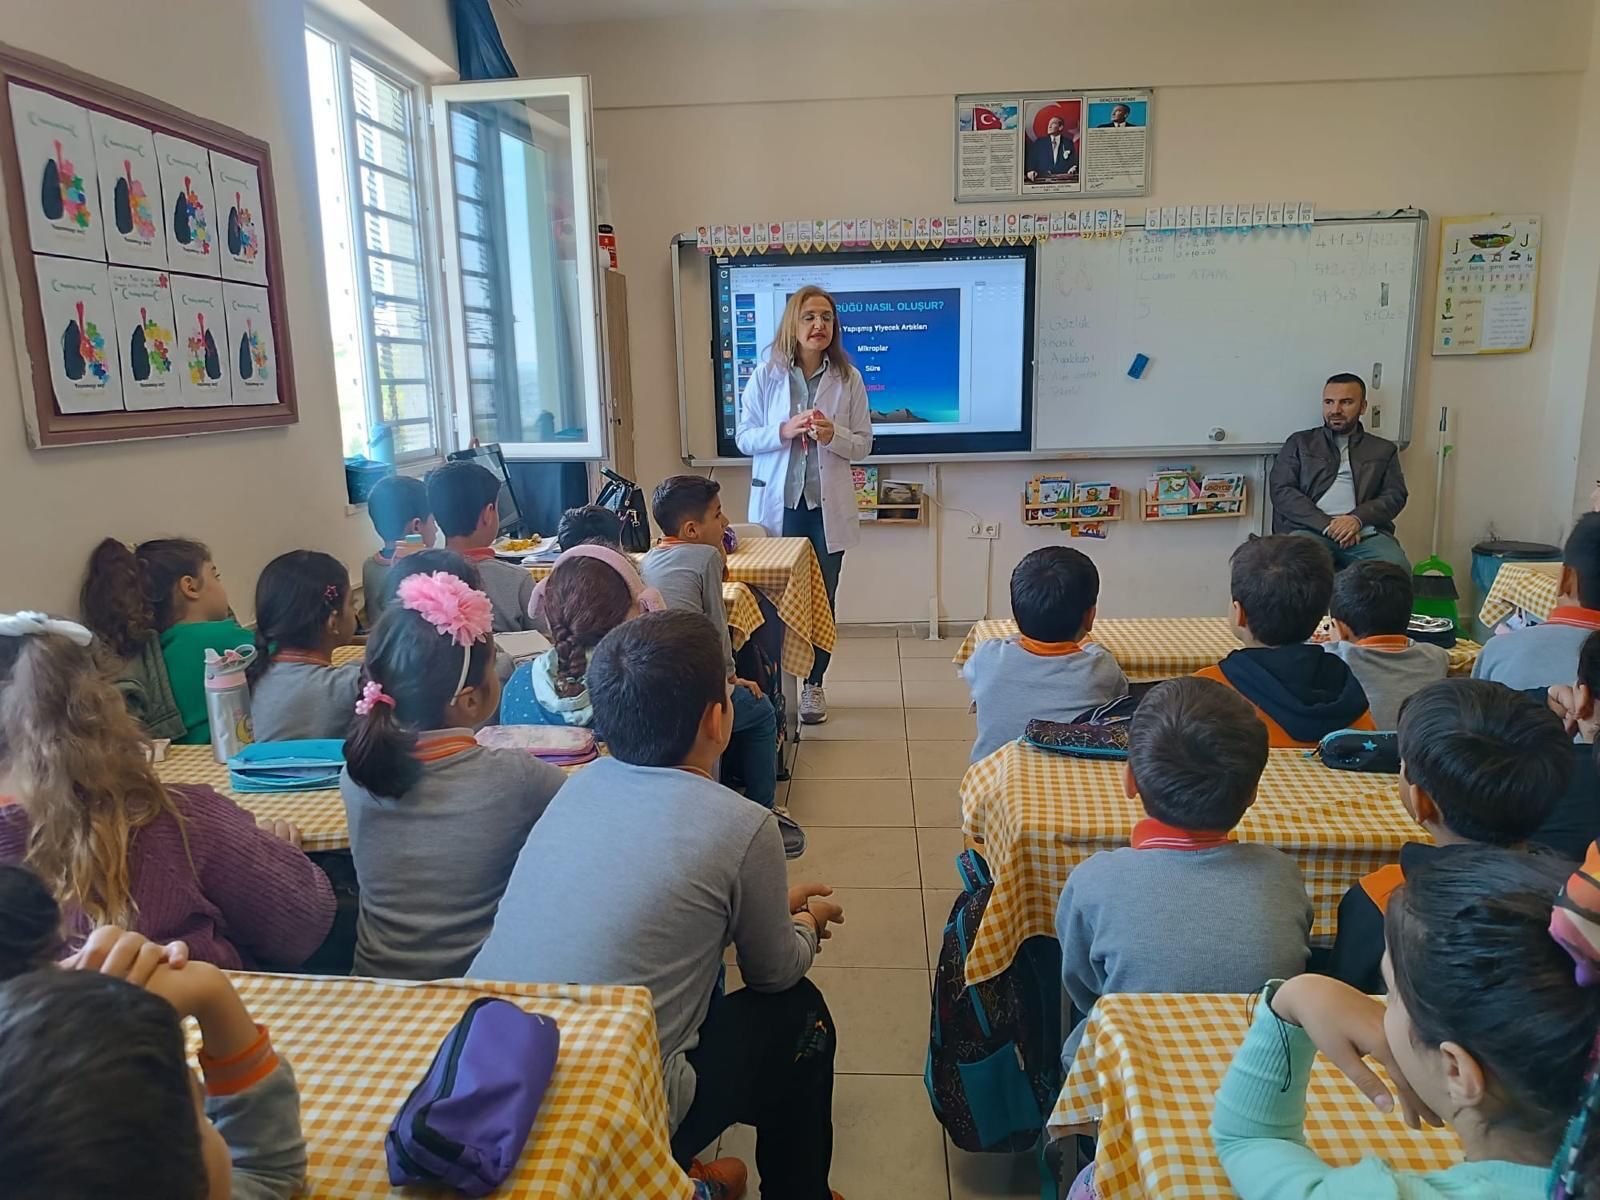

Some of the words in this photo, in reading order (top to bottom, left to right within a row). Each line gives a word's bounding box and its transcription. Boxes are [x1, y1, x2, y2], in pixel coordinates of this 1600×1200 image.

[1242, 216, 1247, 224] 6
[916, 229, 928, 237] Mm
[836, 302, 863, 312] RÜĞÜ
[865, 303, 894, 312] NASIL
[897, 301, 944, 313] OLUŞUR?
[857, 344, 889, 353] Mikroplar
